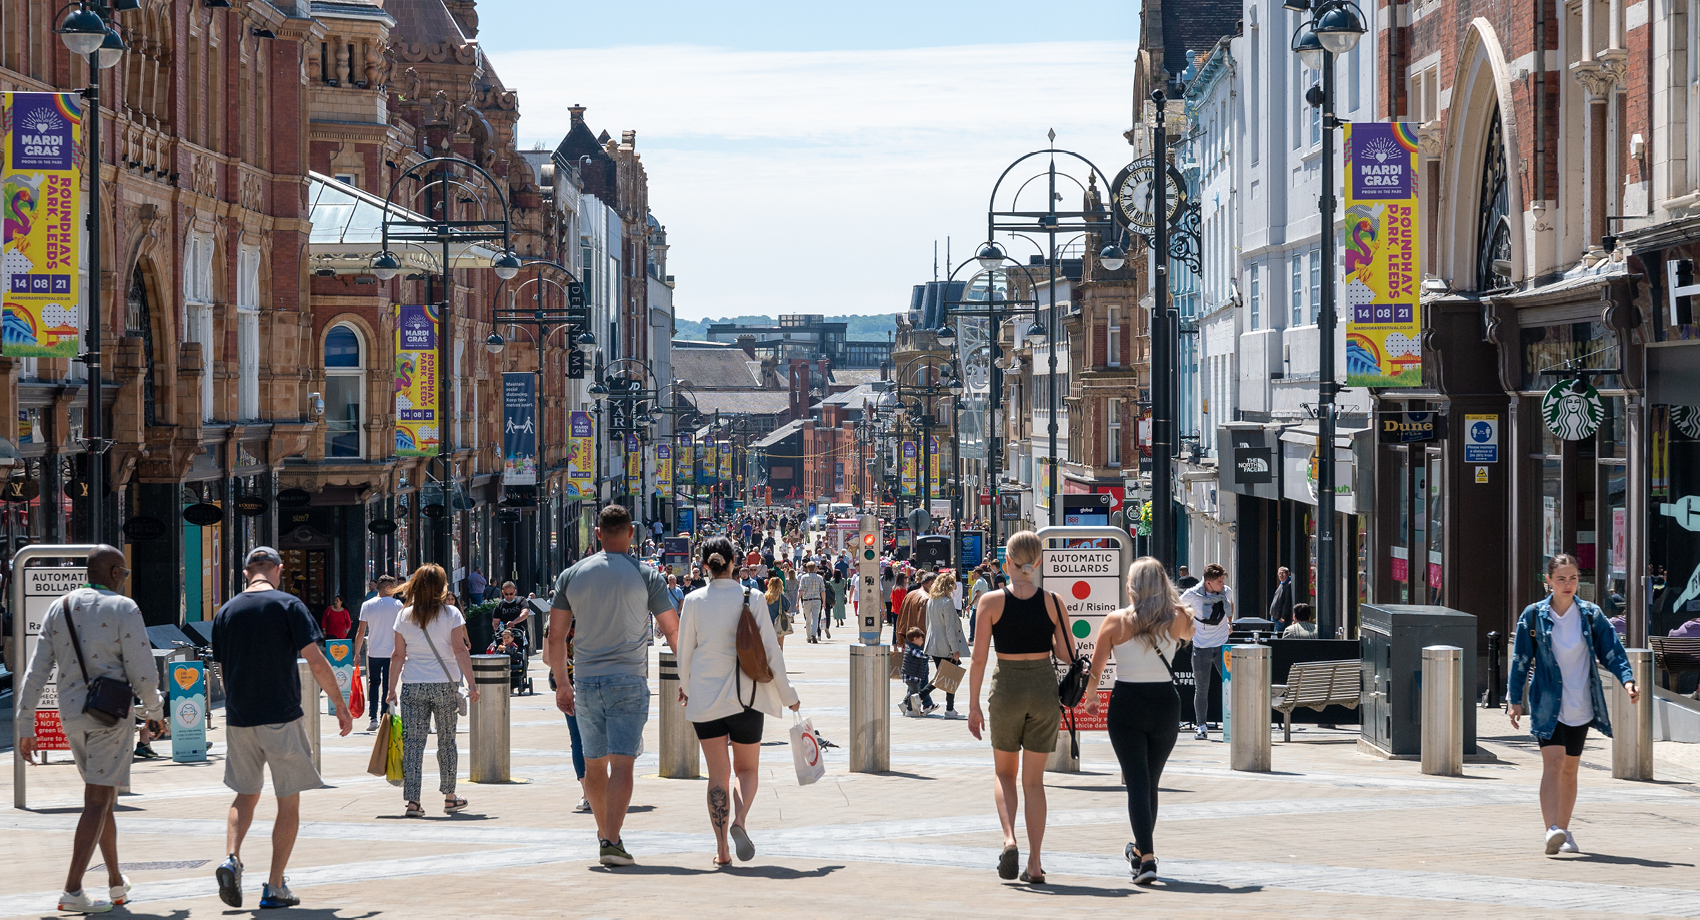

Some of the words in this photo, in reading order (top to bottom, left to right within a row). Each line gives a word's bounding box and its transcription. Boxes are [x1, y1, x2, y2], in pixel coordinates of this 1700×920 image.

[21, 135, 63, 146] MARDI
[24, 146, 60, 156] GRAS
[1361, 164, 1402, 175] MARDI
[1364, 175, 1399, 186] GRAS
[46, 225, 58, 270] LEEDS
[1388, 254, 1400, 299] LEEDS
[14, 279, 27, 288] 14
[33, 279, 48, 289] 08
[55, 279, 66, 289] 21
[1357, 309, 1370, 318] 14
[1376, 308, 1391, 318] 08
[1398, 308, 1409, 318] 21
[571, 286, 581, 375] DENHAMS
[628, 381, 640, 390] JD
[1384, 420, 1433, 432] Dune
[292, 513, 309, 521] size?
[1050, 554, 1112, 562] AUTOMATIC
[1053, 564, 1109, 572] BOLLARDS
[32, 573, 87, 582] AUTOMATI
[502, 606, 520, 615] BOSS
[1086, 602, 1116, 612] Rising
